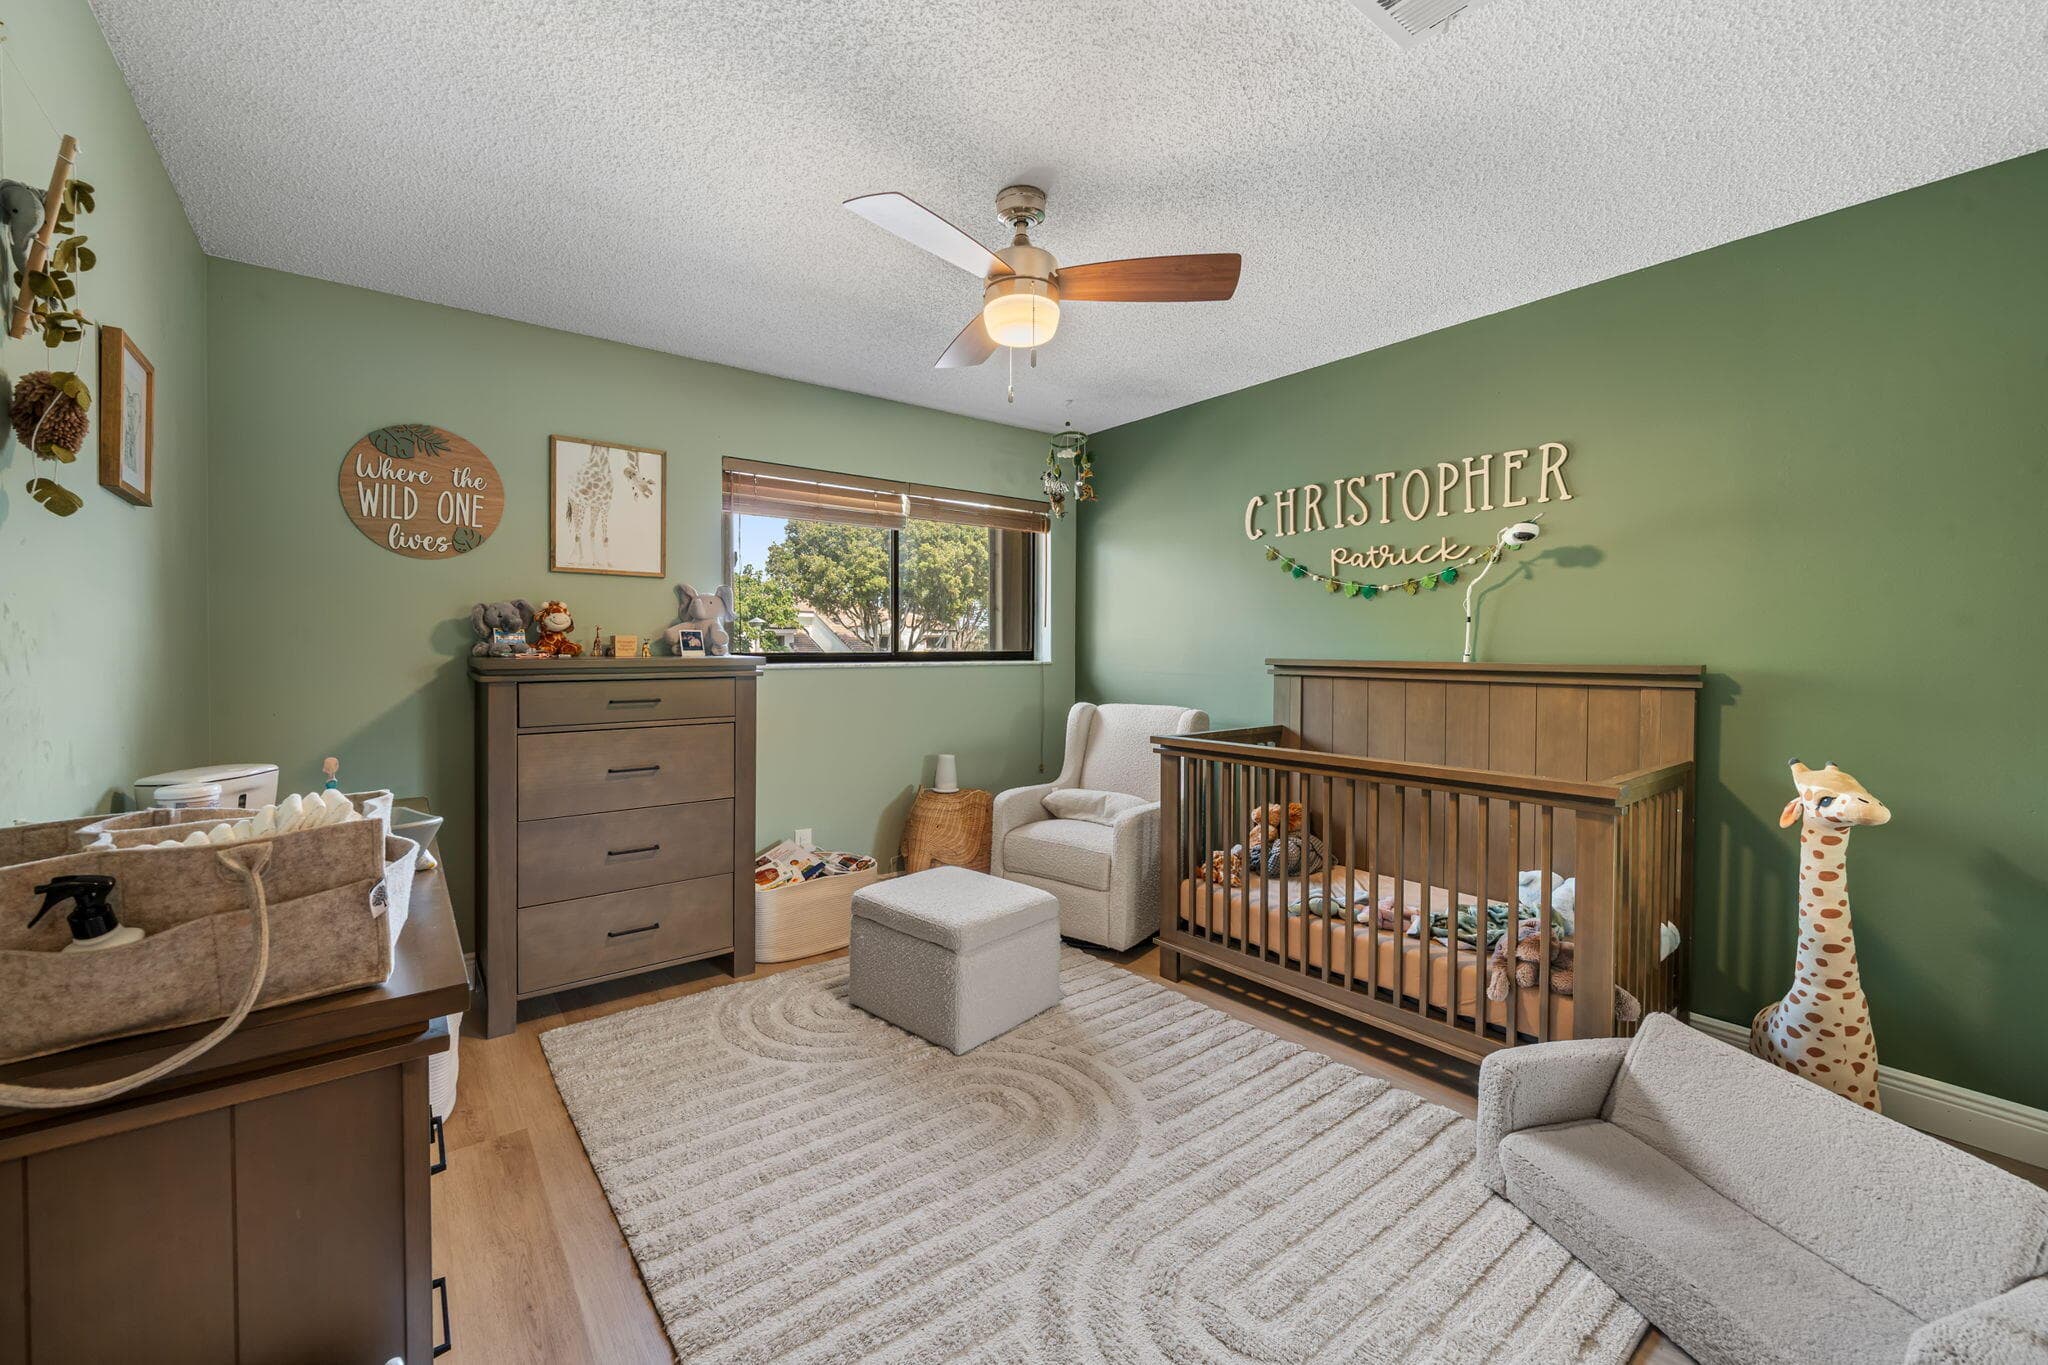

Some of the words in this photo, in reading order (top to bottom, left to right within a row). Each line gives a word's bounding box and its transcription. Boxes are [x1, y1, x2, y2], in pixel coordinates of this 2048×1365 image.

[356, 453, 433, 486] Where
[452, 467, 487, 491] the
[1245, 442, 1574, 541] CHRISTOPHER
[358, 482, 418, 520] WILD
[438, 491, 485, 528] ONE
[388, 523, 452, 552] lives
